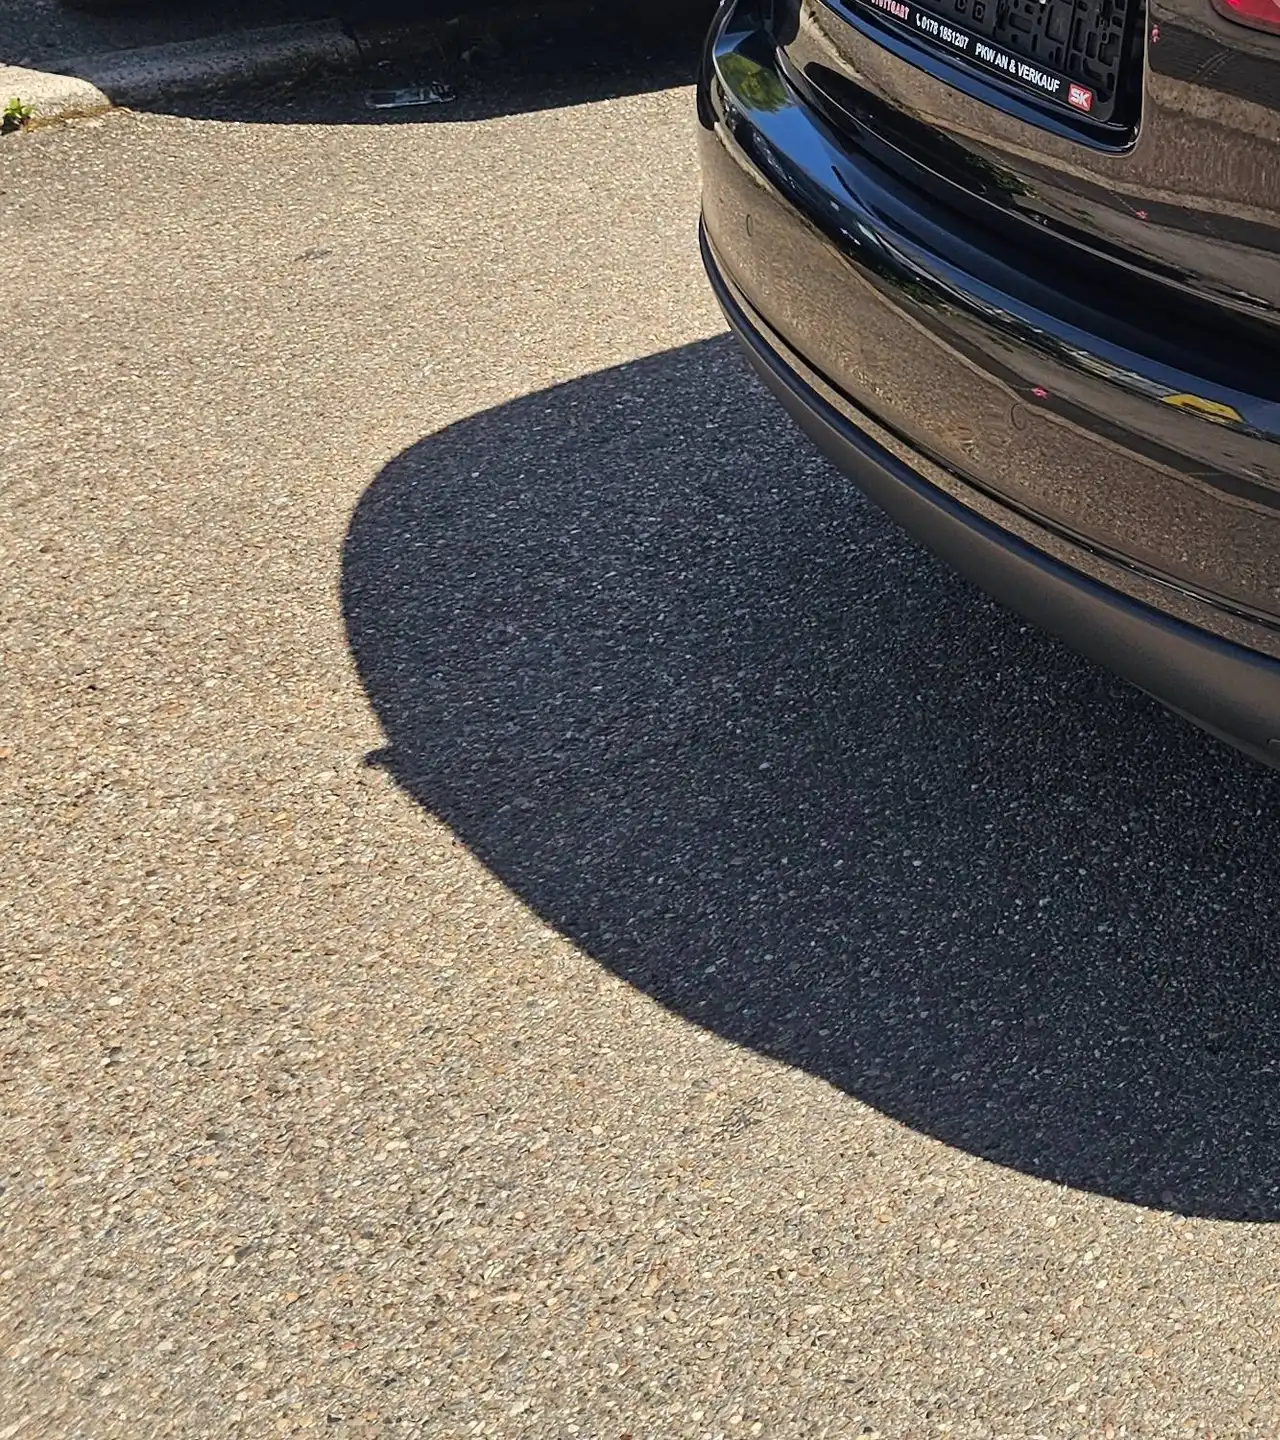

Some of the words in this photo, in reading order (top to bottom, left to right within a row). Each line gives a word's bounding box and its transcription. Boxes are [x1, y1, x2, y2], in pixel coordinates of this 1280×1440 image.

[921, 17, 939, 36] 0178
[939, 25, 969, 50] 1851207
[975, 42, 995, 63] PKW
[995, 53, 1009, 71] AN
[1008, 59, 1016, 74] &
[1017, 62, 1061, 93] VERKAUF
